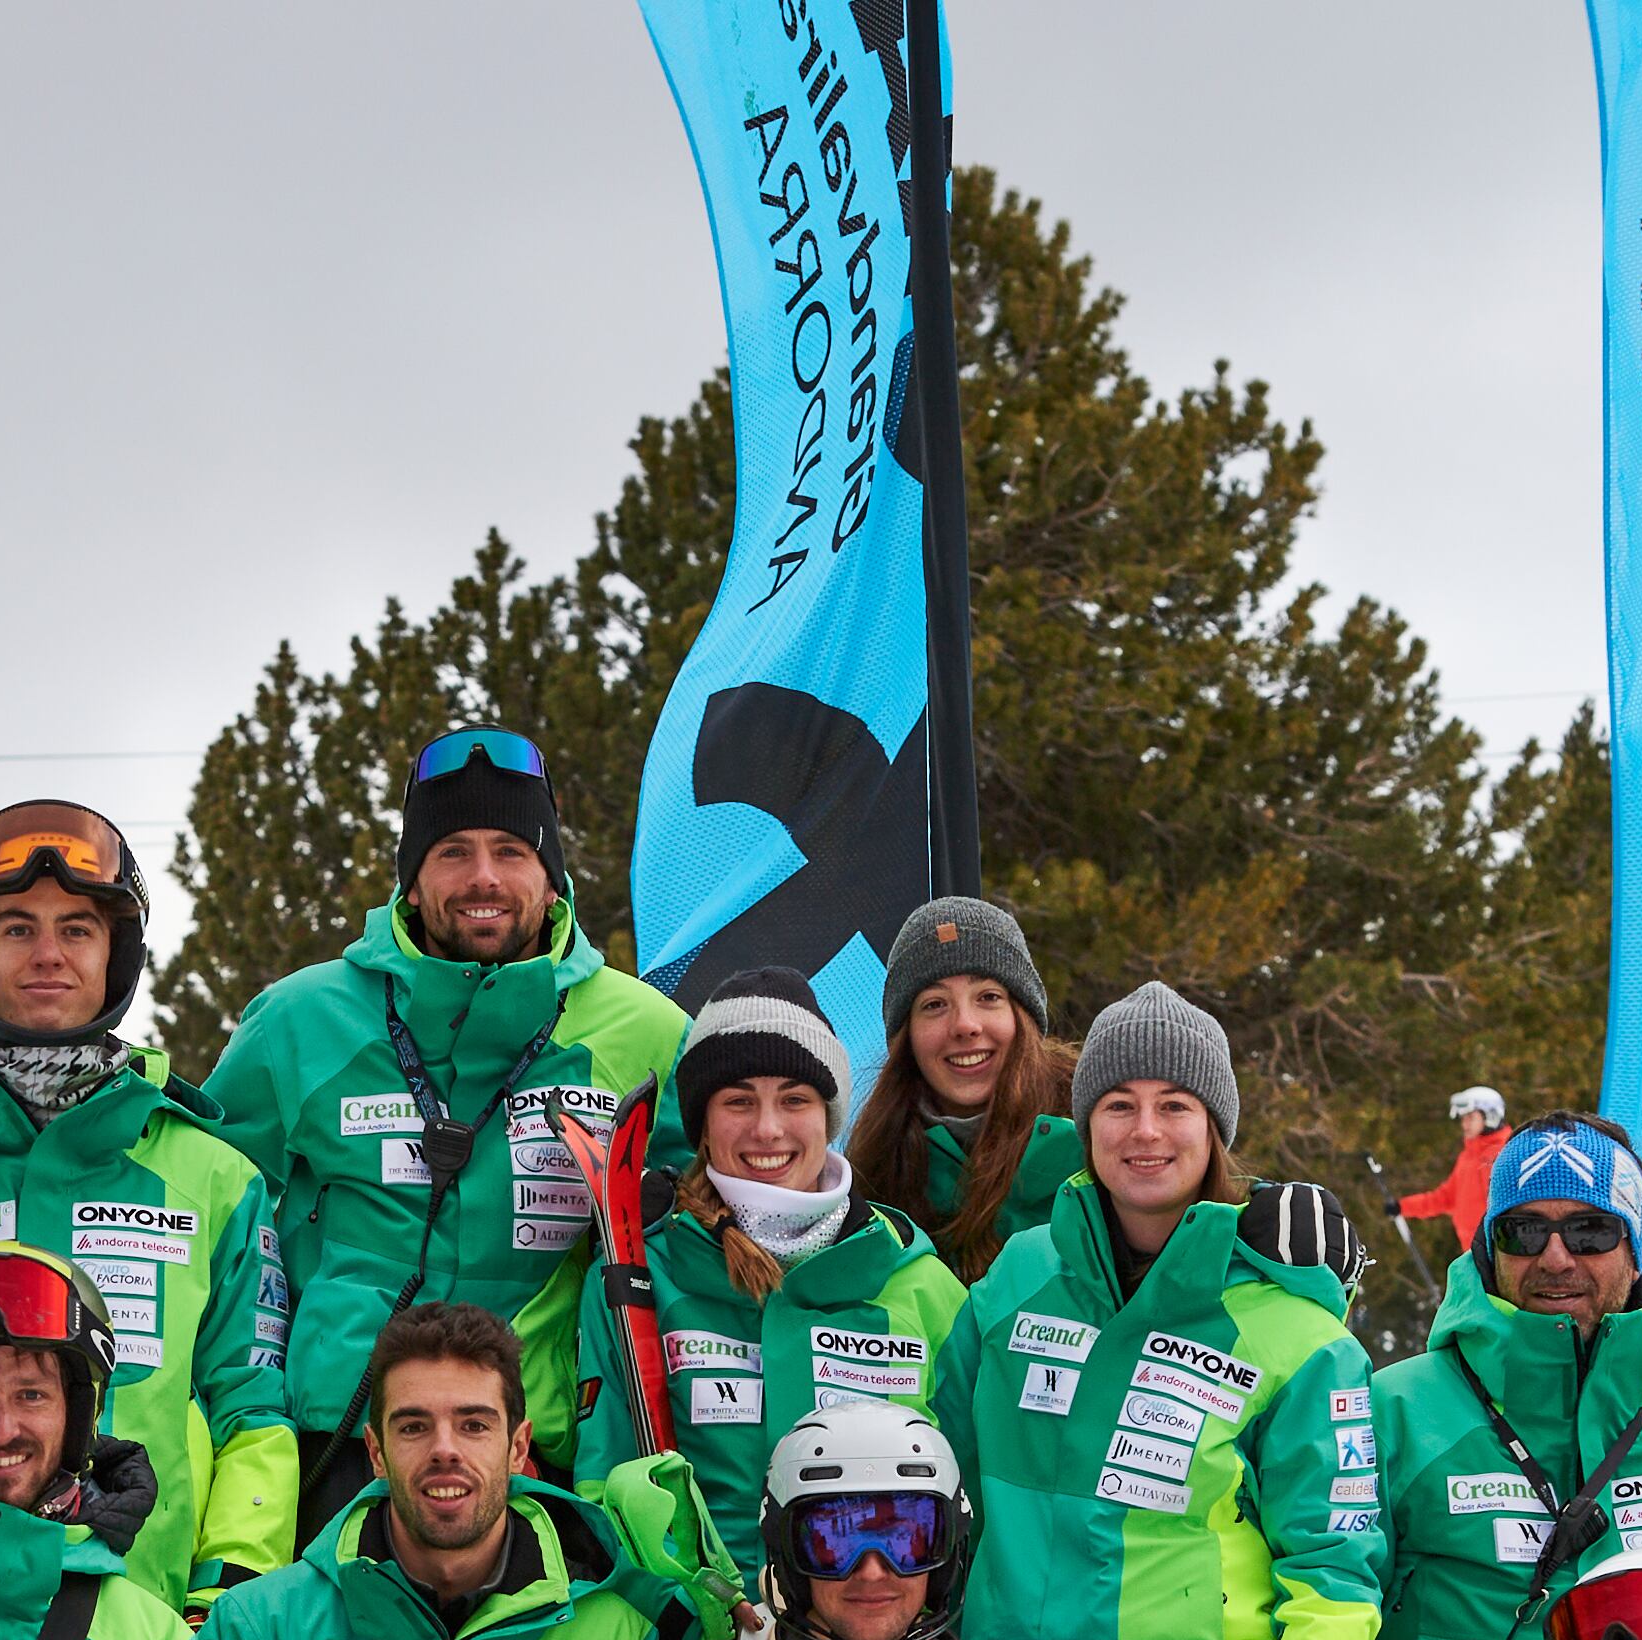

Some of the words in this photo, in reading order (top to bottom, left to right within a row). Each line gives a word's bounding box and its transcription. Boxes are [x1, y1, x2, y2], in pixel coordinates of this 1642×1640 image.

[344, 1101, 421, 1121] Crean
[537, 1147, 566, 1157] AUTO
[95, 1237, 139, 1250] andorra
[142, 1240, 186, 1256] telecom
[100, 1264, 130, 1274] AUTO
[97, 1273, 153, 1287] FACTORIA
[111, 1309, 150, 1321] ENTA
[833, 1369, 869, 1383] andorra
[870, 1375, 917, 1386] telecom
[1153, 1373, 1195, 1394] andorra
[1197, 1388, 1239, 1414] telecom
[1142, 1410, 1196, 1432] FACTORIA
[1125, 1485, 1186, 1505] ALTAVISTA
